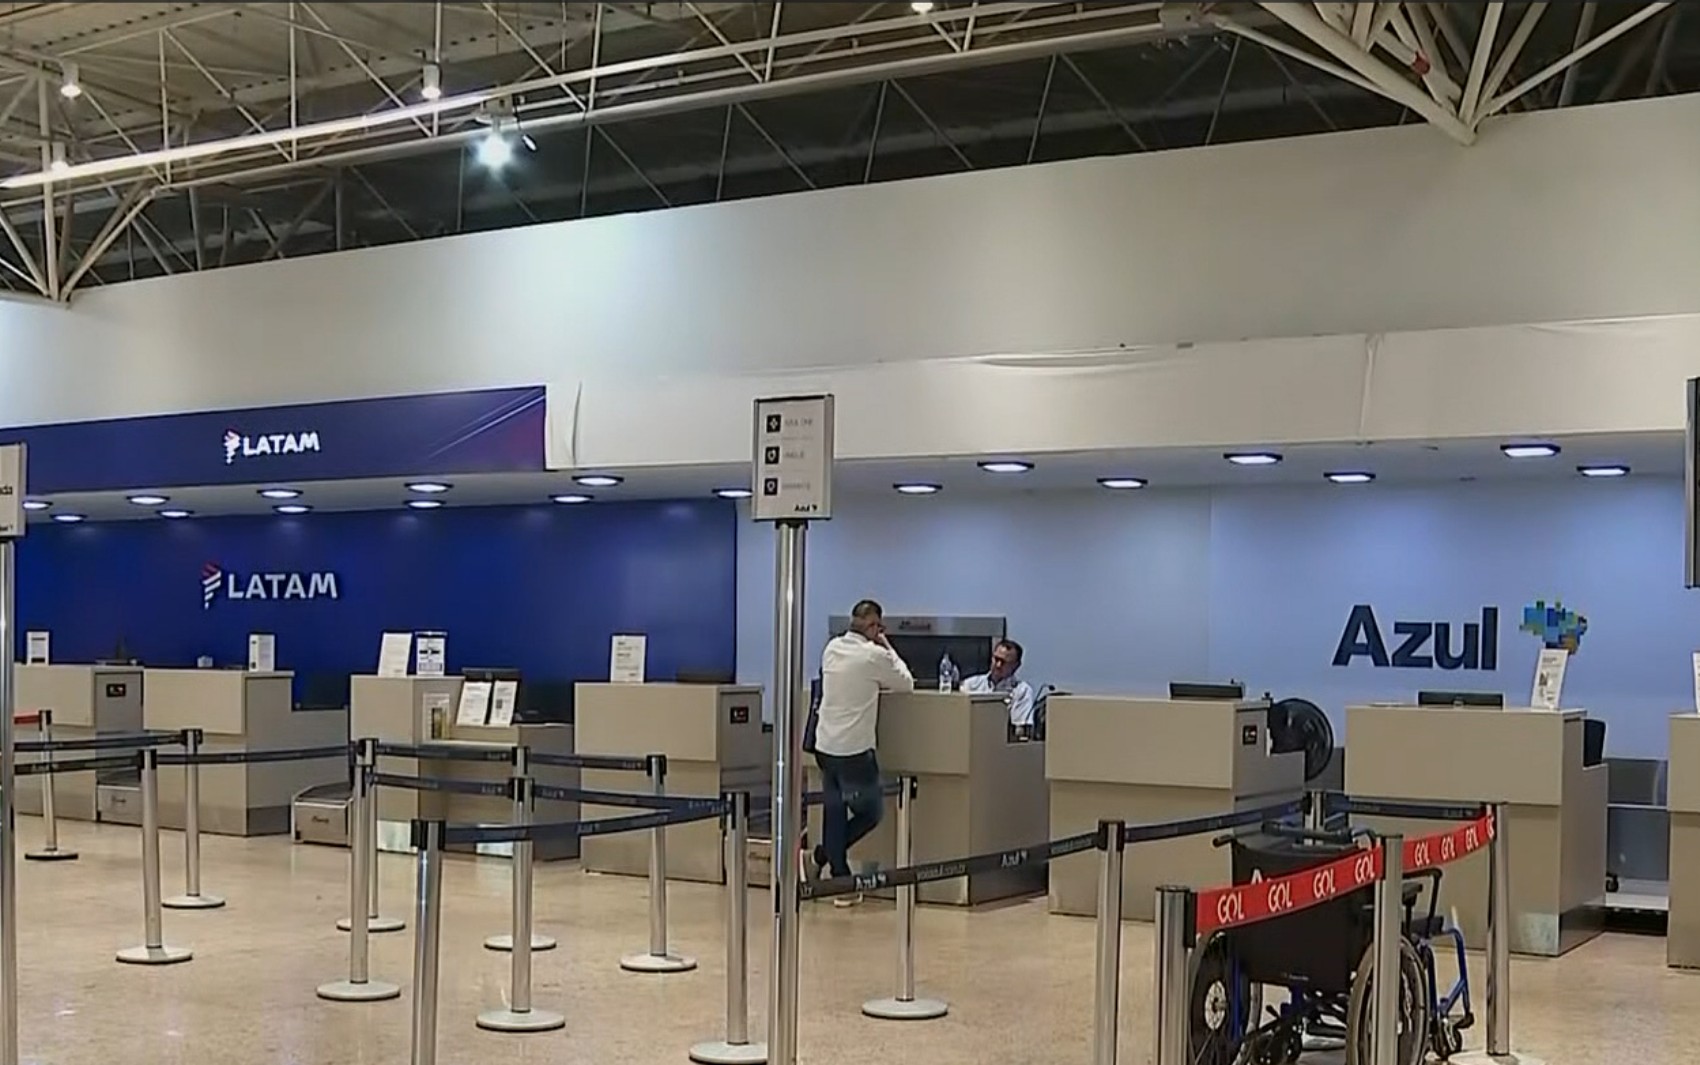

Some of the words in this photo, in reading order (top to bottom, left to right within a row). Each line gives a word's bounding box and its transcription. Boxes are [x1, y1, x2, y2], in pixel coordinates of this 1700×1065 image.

[242, 432, 320, 456] LATAM
[228, 572, 338, 599] LATAM
[1331, 604, 1499, 671] Azul
[1440, 835, 1456, 860] GOL
[1465, 825, 1479, 851] GOL
[1413, 841, 1431, 867] GOL
[1354, 854, 1376, 884] GOL
[1267, 881, 1293, 912] GOL
[1312, 868, 1336, 899] GOL
[1216, 890, 1245, 924] GOL
